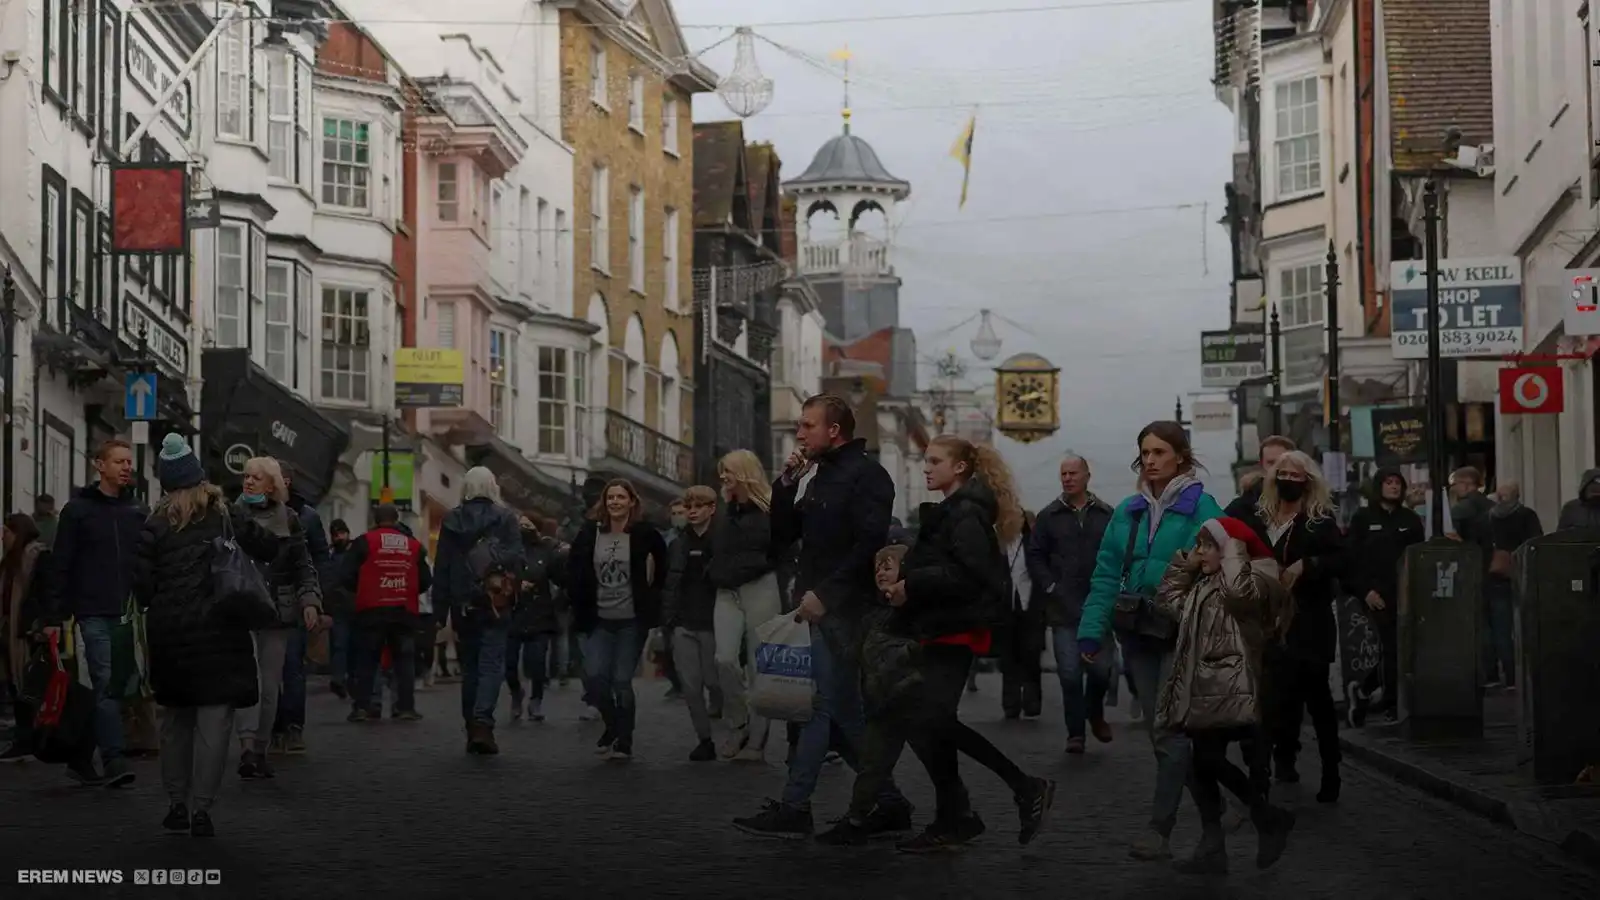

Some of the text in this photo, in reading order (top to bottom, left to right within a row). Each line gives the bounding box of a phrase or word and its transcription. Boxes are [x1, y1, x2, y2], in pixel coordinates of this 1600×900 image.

[1466, 265, 1514, 281] KEIL
[1457, 304, 1503, 328] LET
[1398, 334, 1428, 346] 020
[1475, 330, 1518, 346] 9024
[271, 419, 298, 448] GANT
